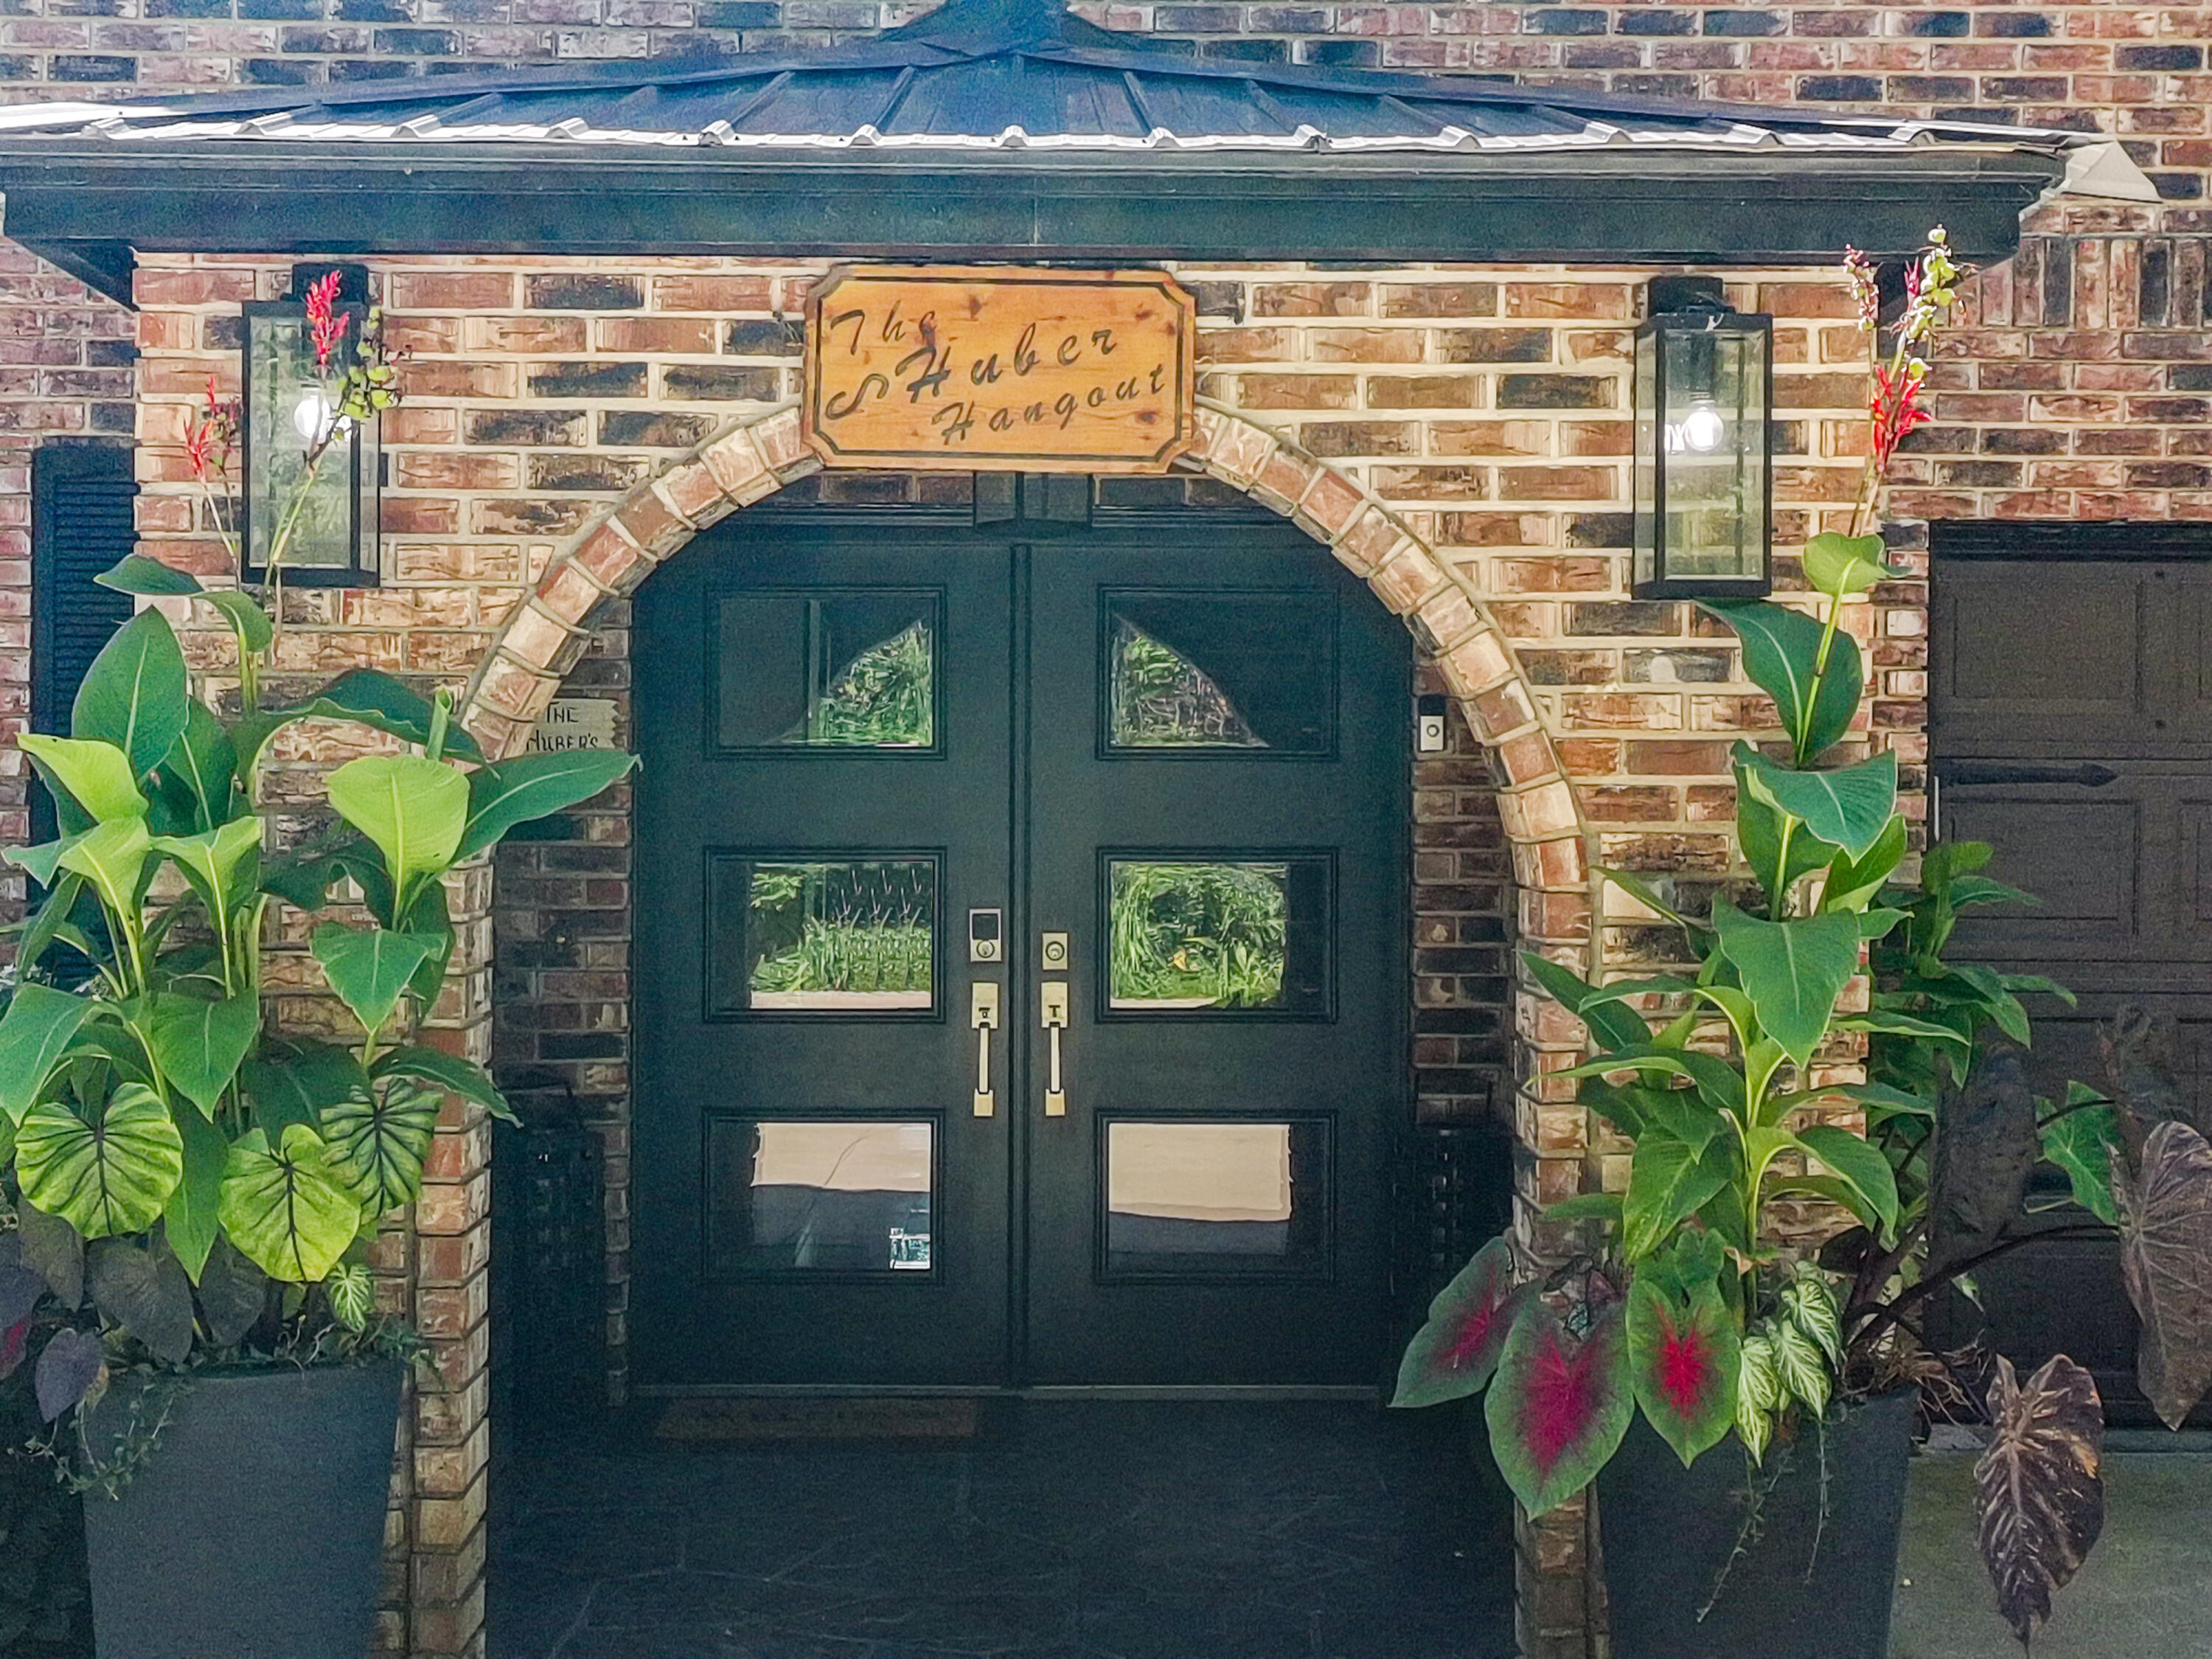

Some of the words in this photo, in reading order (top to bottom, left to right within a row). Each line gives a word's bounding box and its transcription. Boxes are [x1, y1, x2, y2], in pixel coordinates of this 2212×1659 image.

[830, 299, 936, 355] The
[894, 322, 1117, 403] Huber
[931, 363, 1165, 445] Hangout
[547, 701, 579, 723] THE
